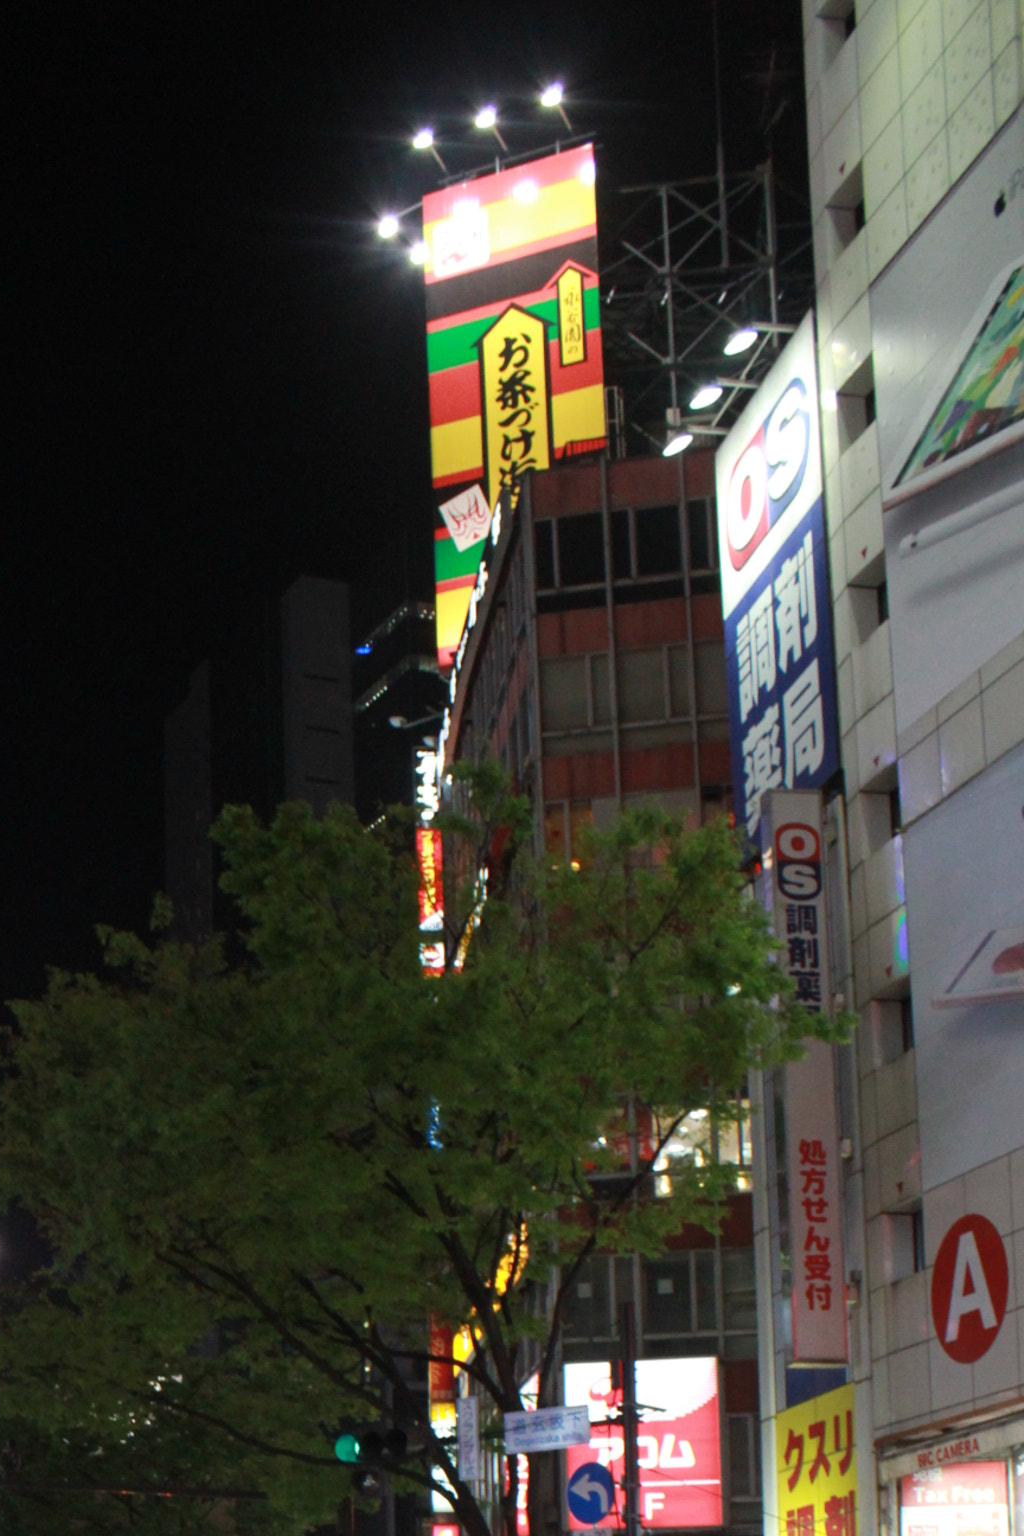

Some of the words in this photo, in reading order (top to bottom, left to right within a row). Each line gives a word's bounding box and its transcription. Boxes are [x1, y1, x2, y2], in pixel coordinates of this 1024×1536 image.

[728, 378, 810, 562] OS
[735, 530, 817, 724] 調剤
[742, 659, 823, 837] 薬局
[777, 823, 821, 899] OS
[786, 903, 821, 1015] 調剤薬
[799, 1139, 832, 1311] 処方せん受付
[513, 1411, 583, 1435] 道玄坂下
[589, 1434, 695, 1469] アコム
[784, 1410, 852, 1493] クスリ
[936, 1438, 979, 1464] CAMERA
[913, 1487, 948, 1503] Tax
[951, 1486, 996, 1502] Free
